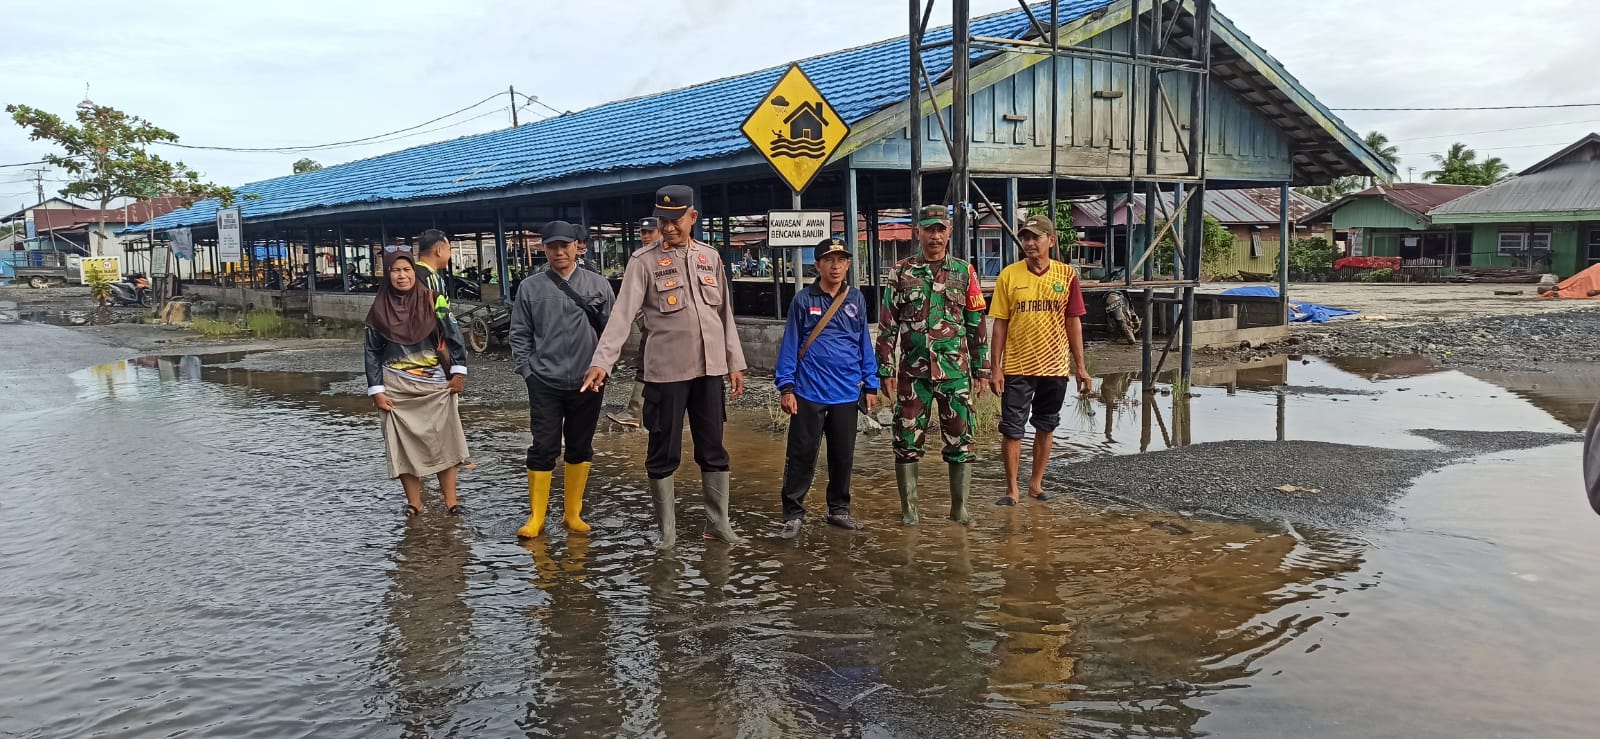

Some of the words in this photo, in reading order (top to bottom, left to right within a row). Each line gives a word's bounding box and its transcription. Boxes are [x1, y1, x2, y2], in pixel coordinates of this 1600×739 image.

[771, 219, 801, 227] KAWASAN
[771, 230, 801, 238] BENCANA
[802, 229, 824, 238] BANJIR
